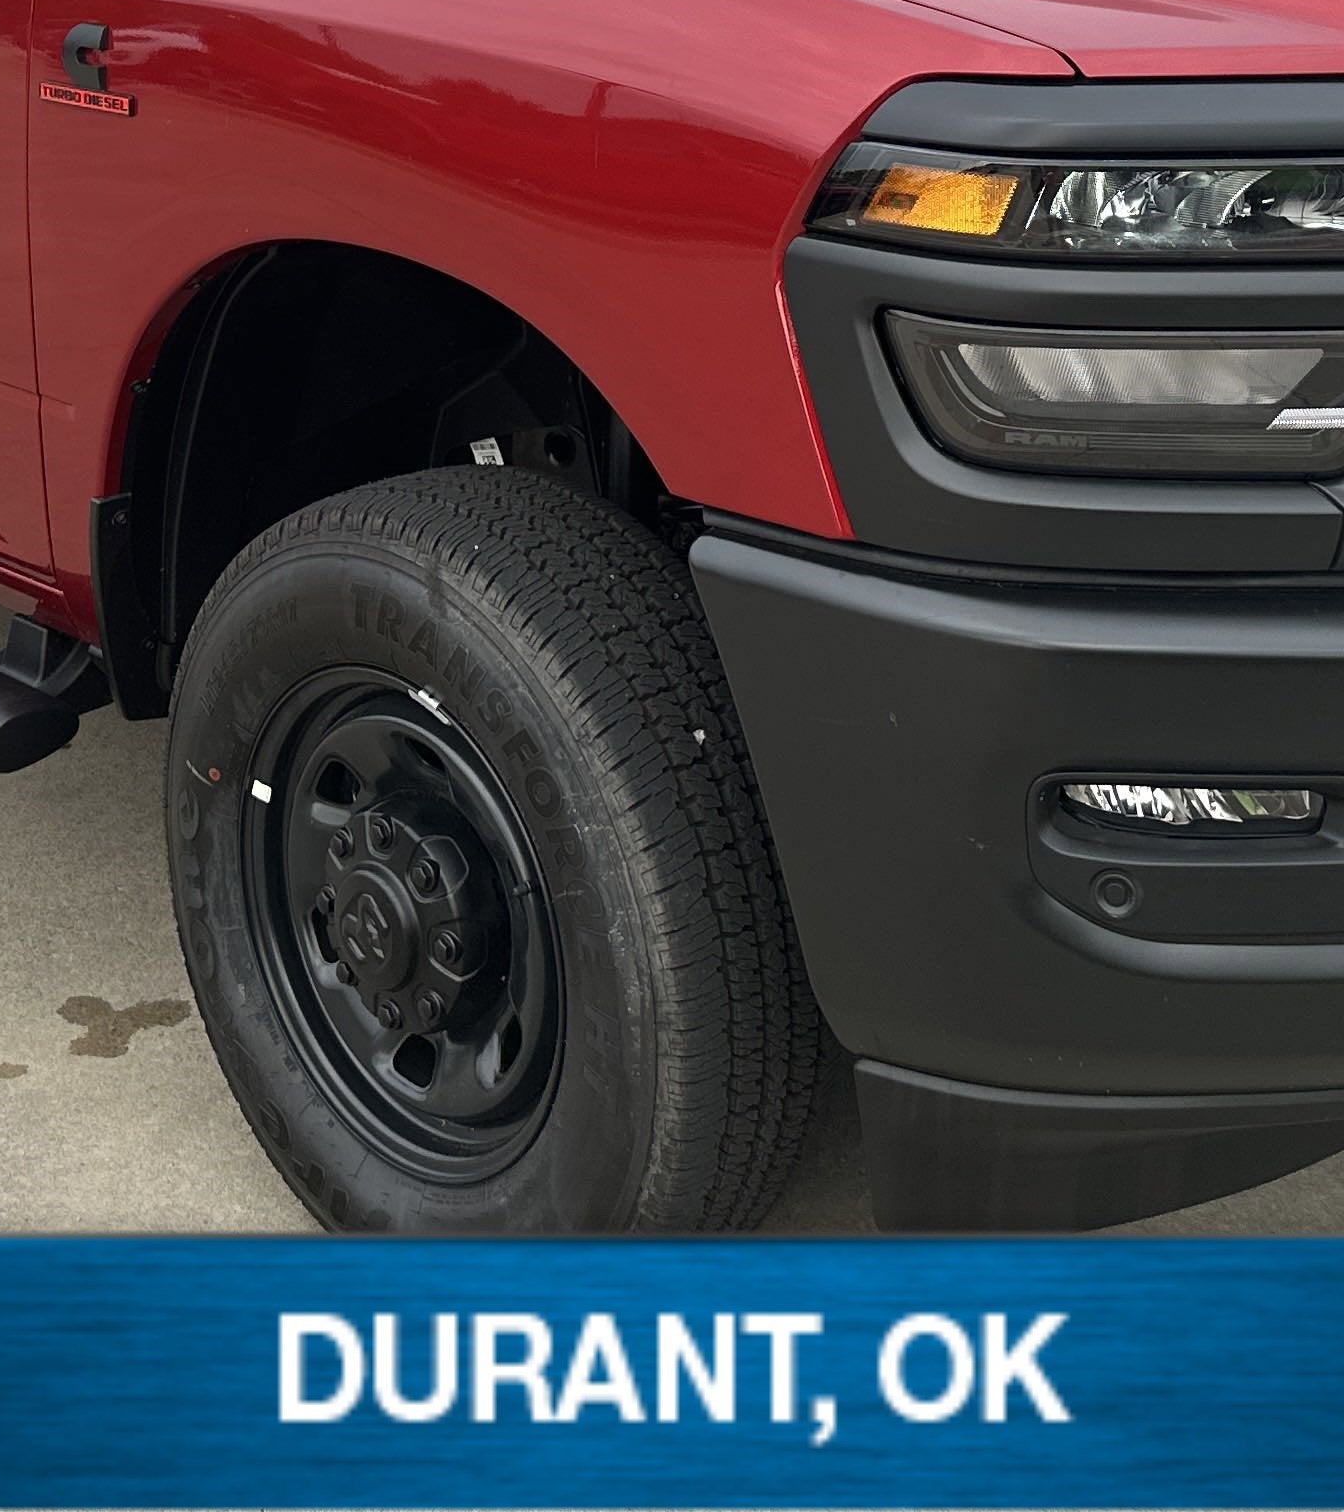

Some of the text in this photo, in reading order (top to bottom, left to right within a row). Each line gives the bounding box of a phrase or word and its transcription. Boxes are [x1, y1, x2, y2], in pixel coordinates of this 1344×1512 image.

[42, 85, 128, 112] TURBO DIESEL
[1004, 431, 1088, 448] RAM
